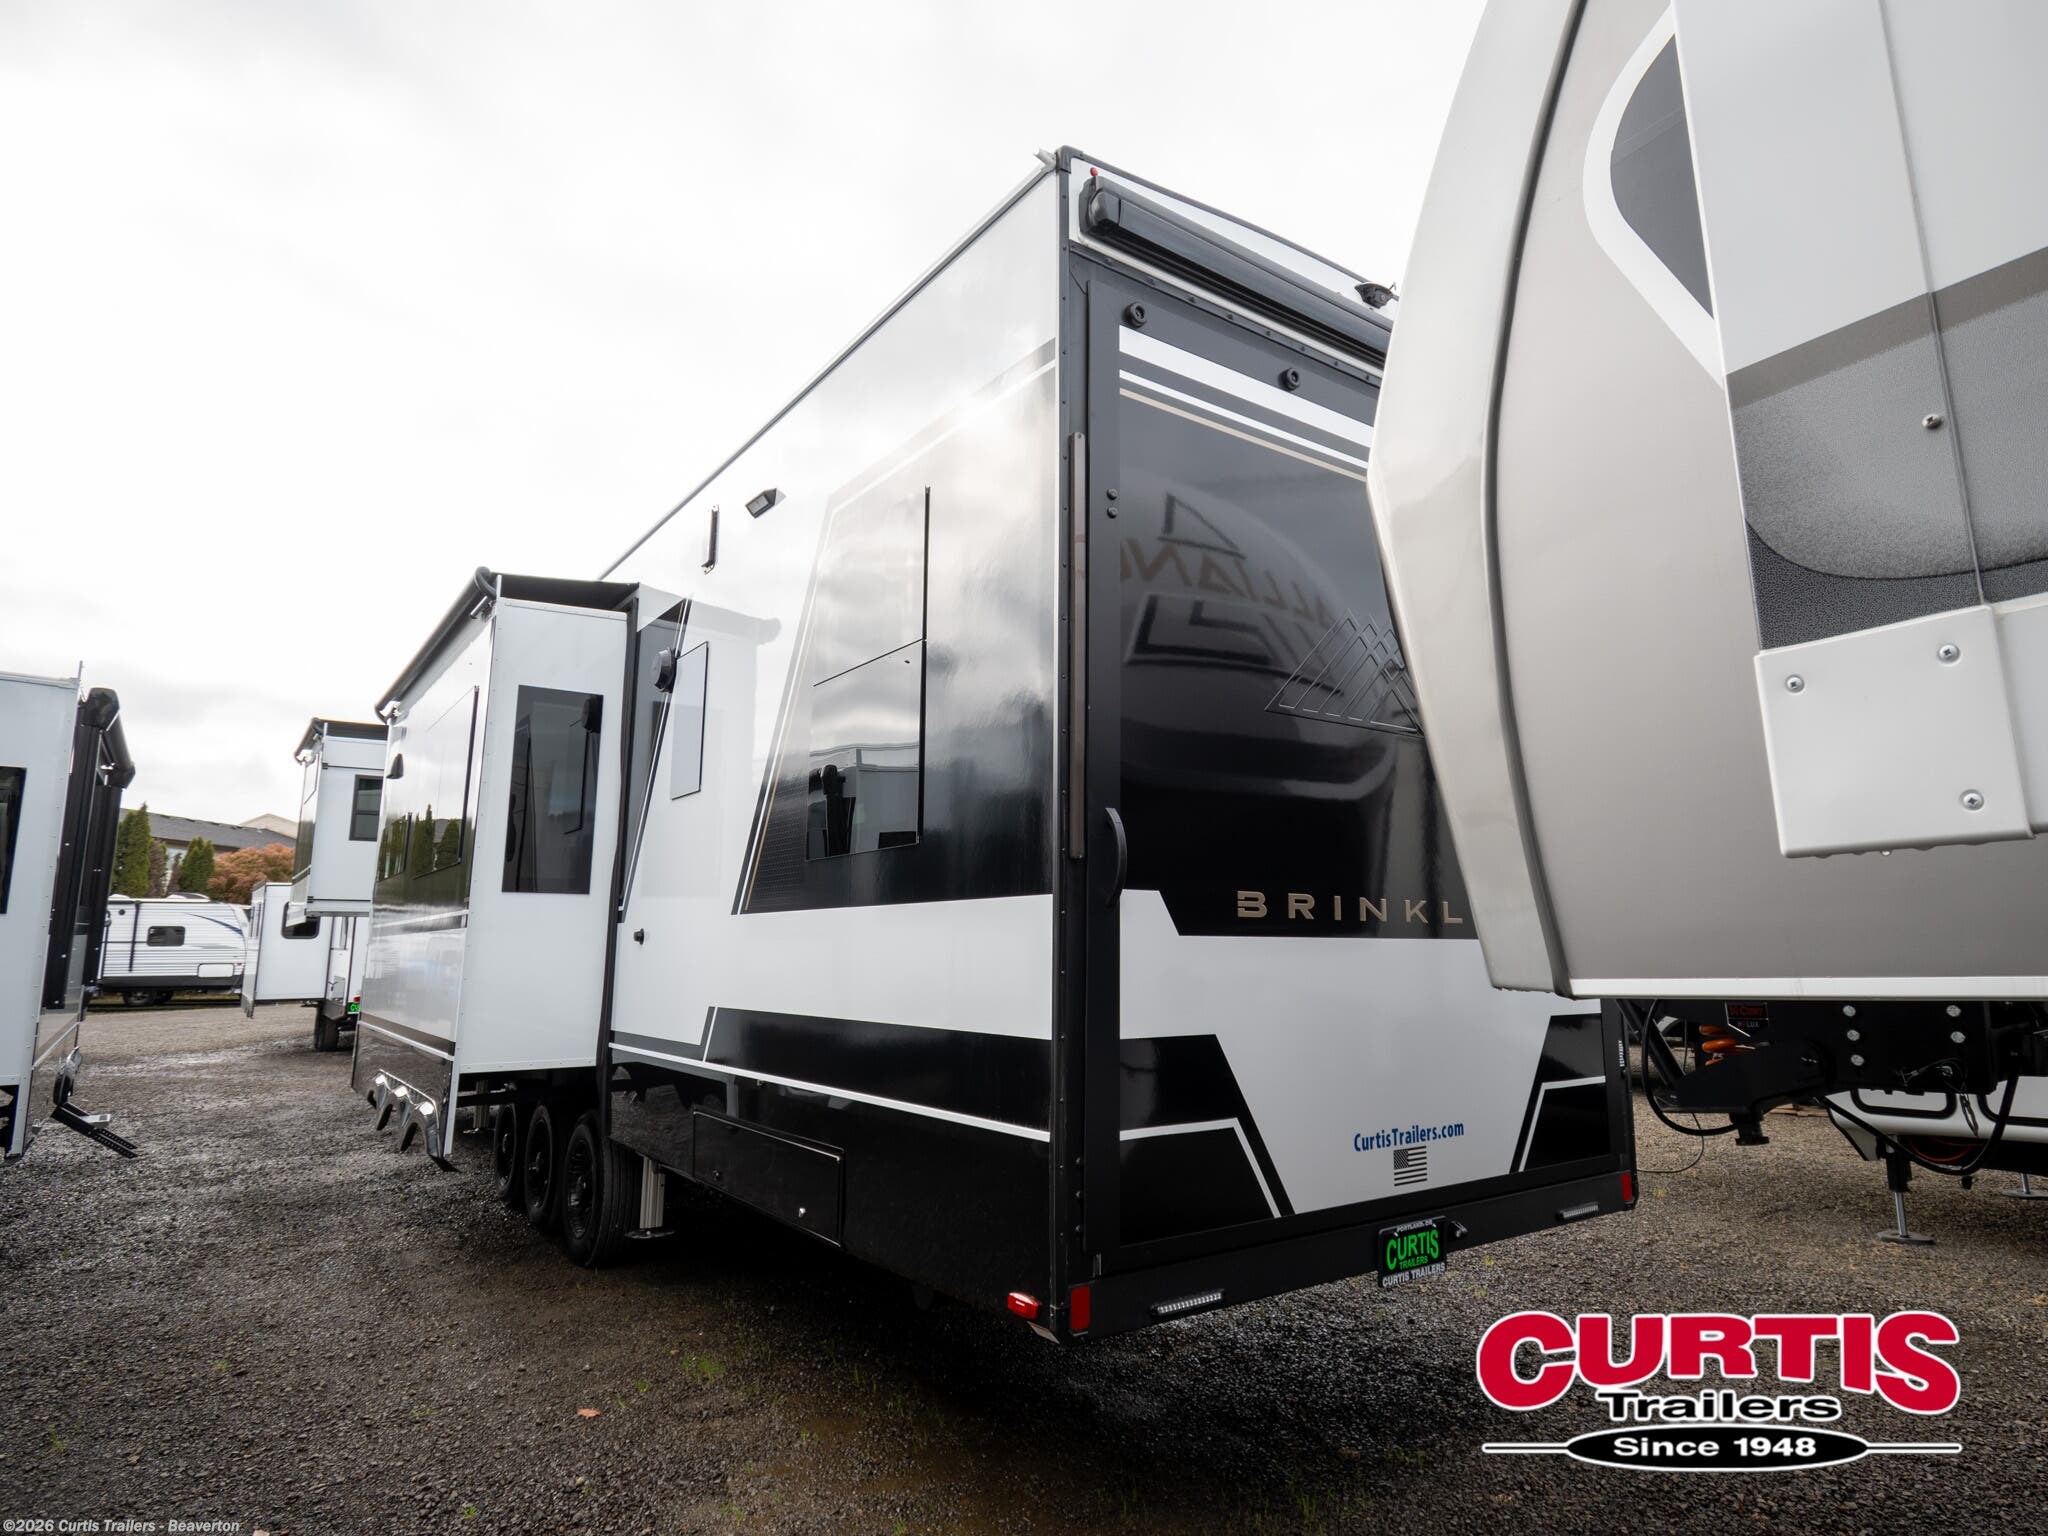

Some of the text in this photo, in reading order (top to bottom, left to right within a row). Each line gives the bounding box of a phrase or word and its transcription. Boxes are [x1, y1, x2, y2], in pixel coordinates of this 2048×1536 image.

[1237, 890, 1464, 924] BRINKL
[1354, 1122, 1464, 1152] CurtisTrailers.com
[1386, 1229, 1439, 1271] CURTIS
[1399, 1256, 1429, 1270] TRAILERS
[1382, 1262, 1446, 1287] CURTIS TRAILERS
